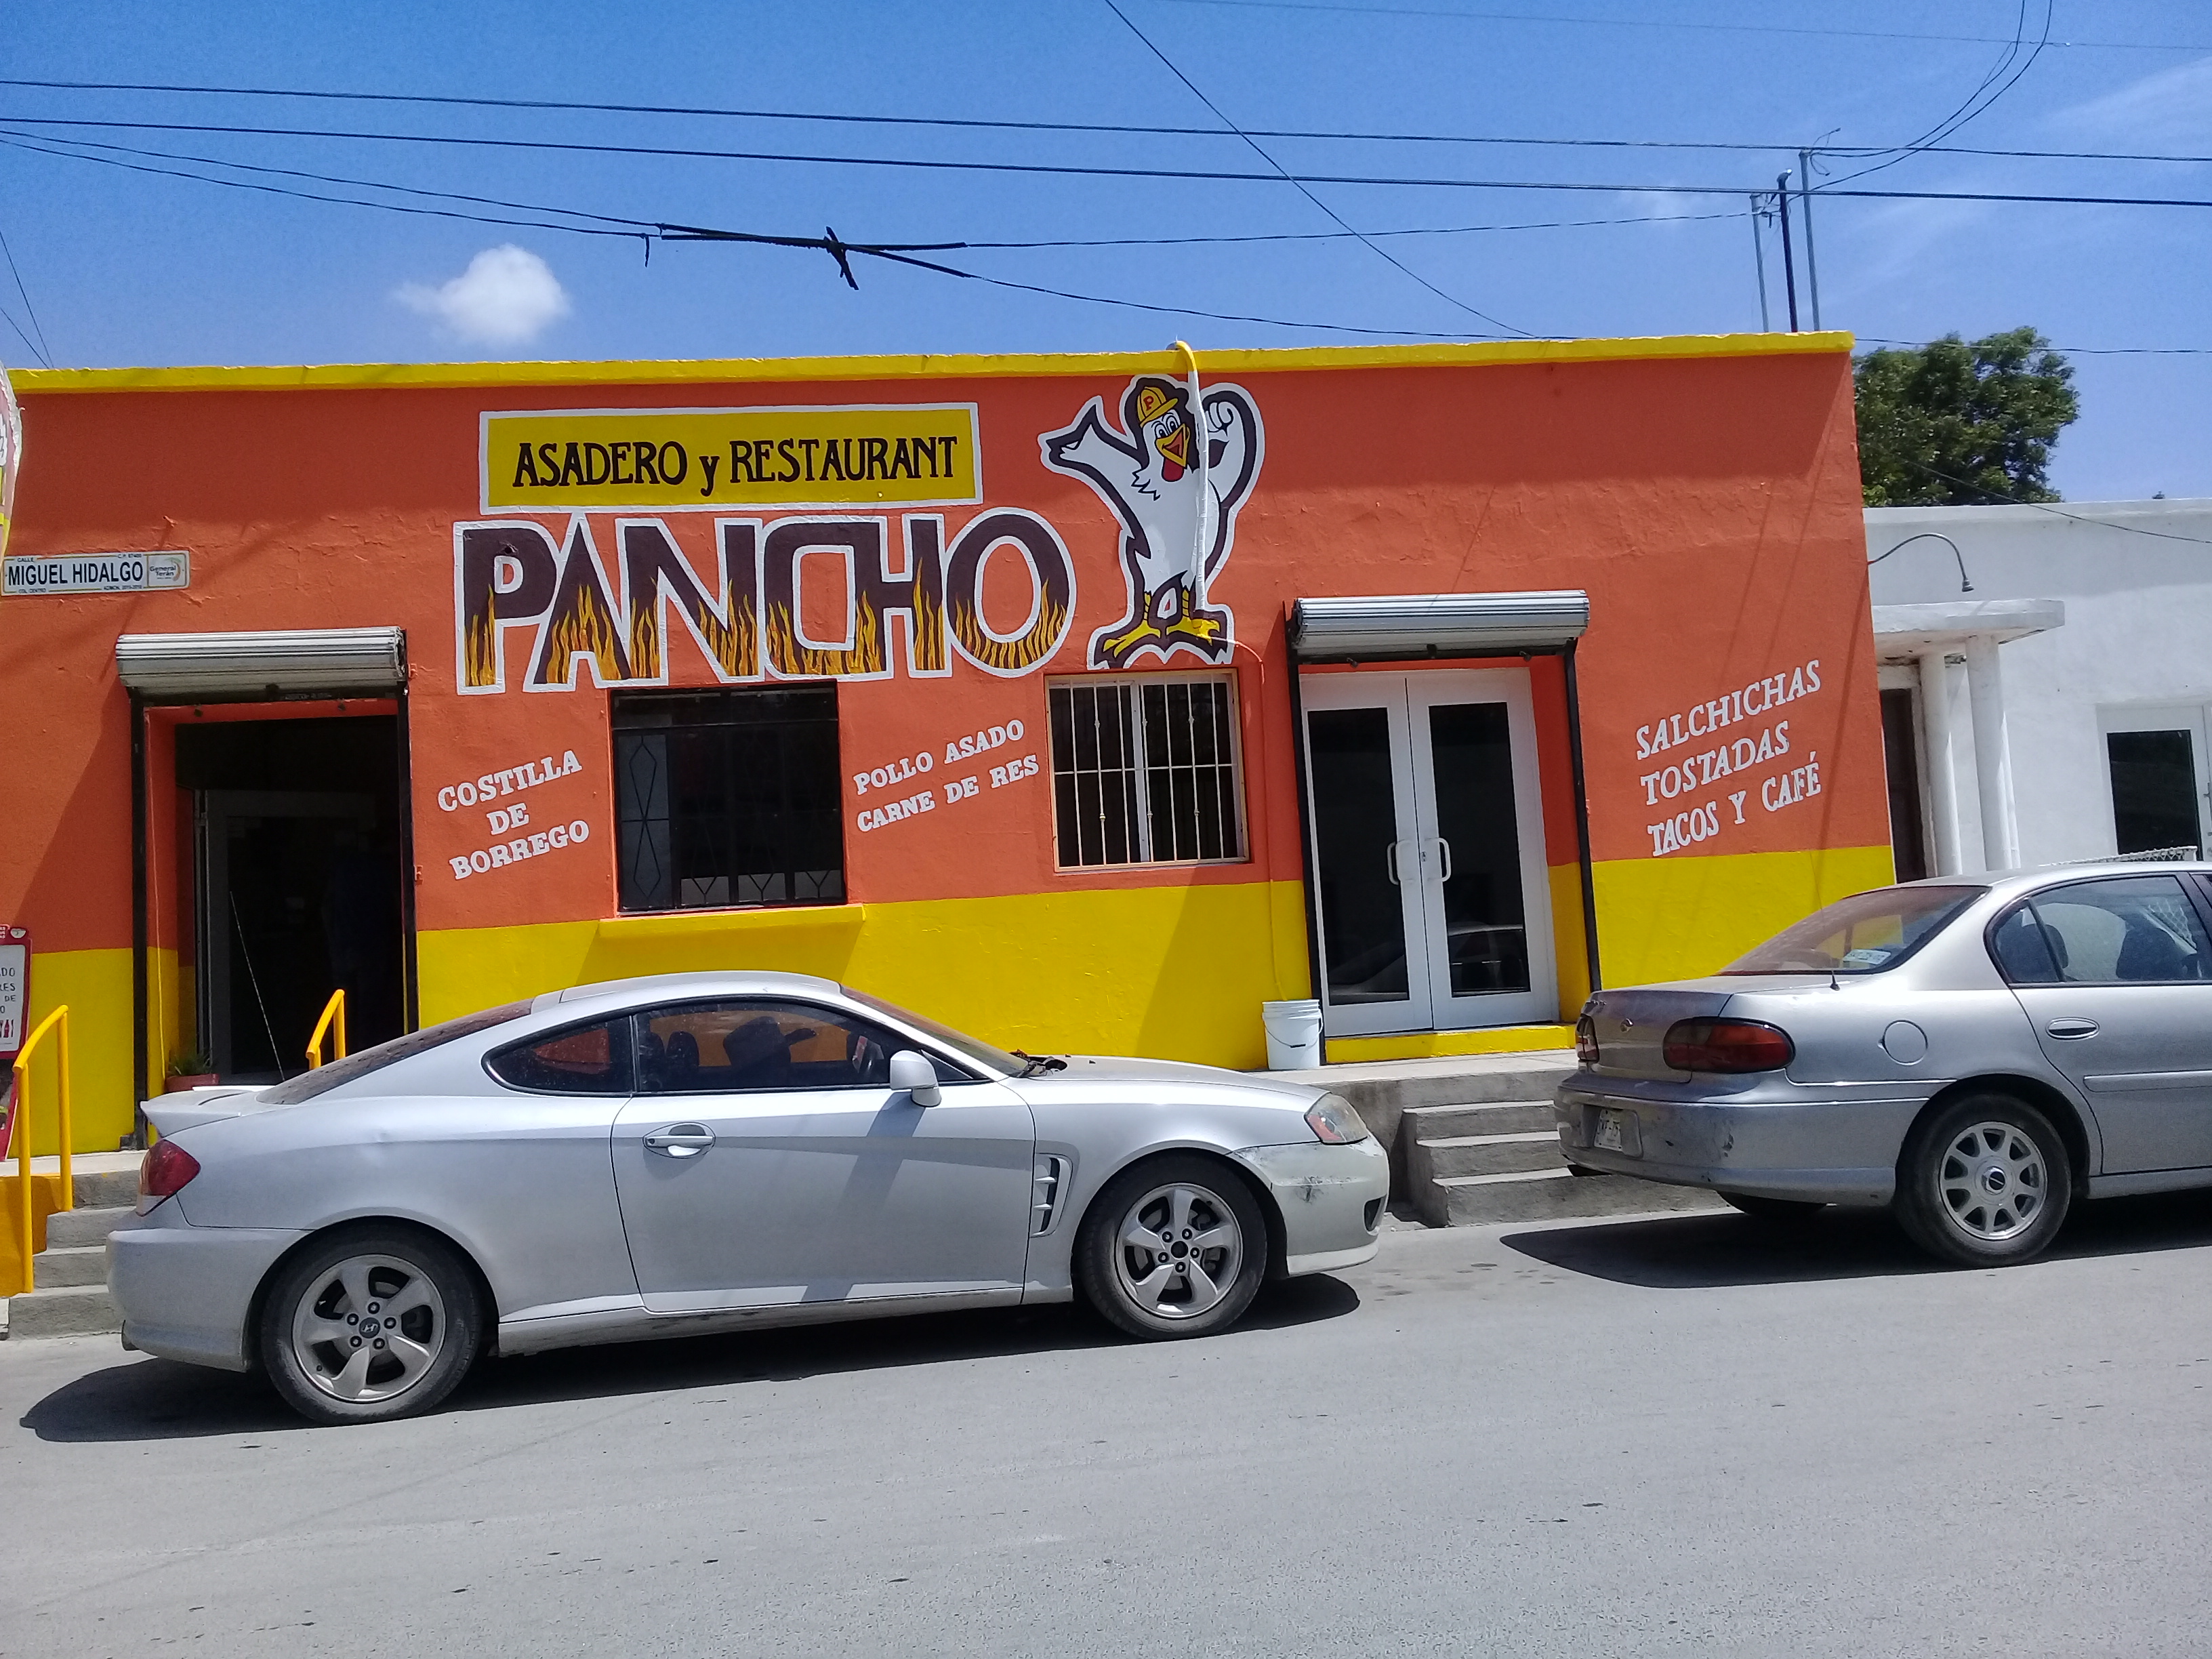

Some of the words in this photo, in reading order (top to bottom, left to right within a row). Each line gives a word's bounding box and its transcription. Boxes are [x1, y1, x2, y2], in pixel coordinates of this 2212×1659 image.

[1143, 395, 1154, 411] P
[512, 441, 687, 487] ASADERO
[699, 456, 720, 497] y
[729, 436, 958, 483] RESTAURANT
[8, 565, 68, 586] MIGUEL
[73, 561, 143, 583] HIDALGO
[455, 508, 1077, 694] PANCHO
[1636, 659, 1822, 760] SALCHICHAS
[438, 750, 583, 812] COSTILLA
[853, 752, 934, 796] POLLO
[944, 720, 1025, 764] ASADO
[1640, 720, 1790, 806] TOSTADAS
[486, 802, 530, 836] DE
[857, 790, 936, 832] CARNE
[943, 776, 980, 804] DE
[989, 754, 1040, 788] RES
[1647, 801, 1719, 857] TACOS
[1727, 790, 1747, 825] Y
[1761, 751, 1822, 812] CAFÉ
[449, 820, 590, 880] BORREGO
[0, 967, 16, 977] DO
[5, 994, 16, 1002] DE
